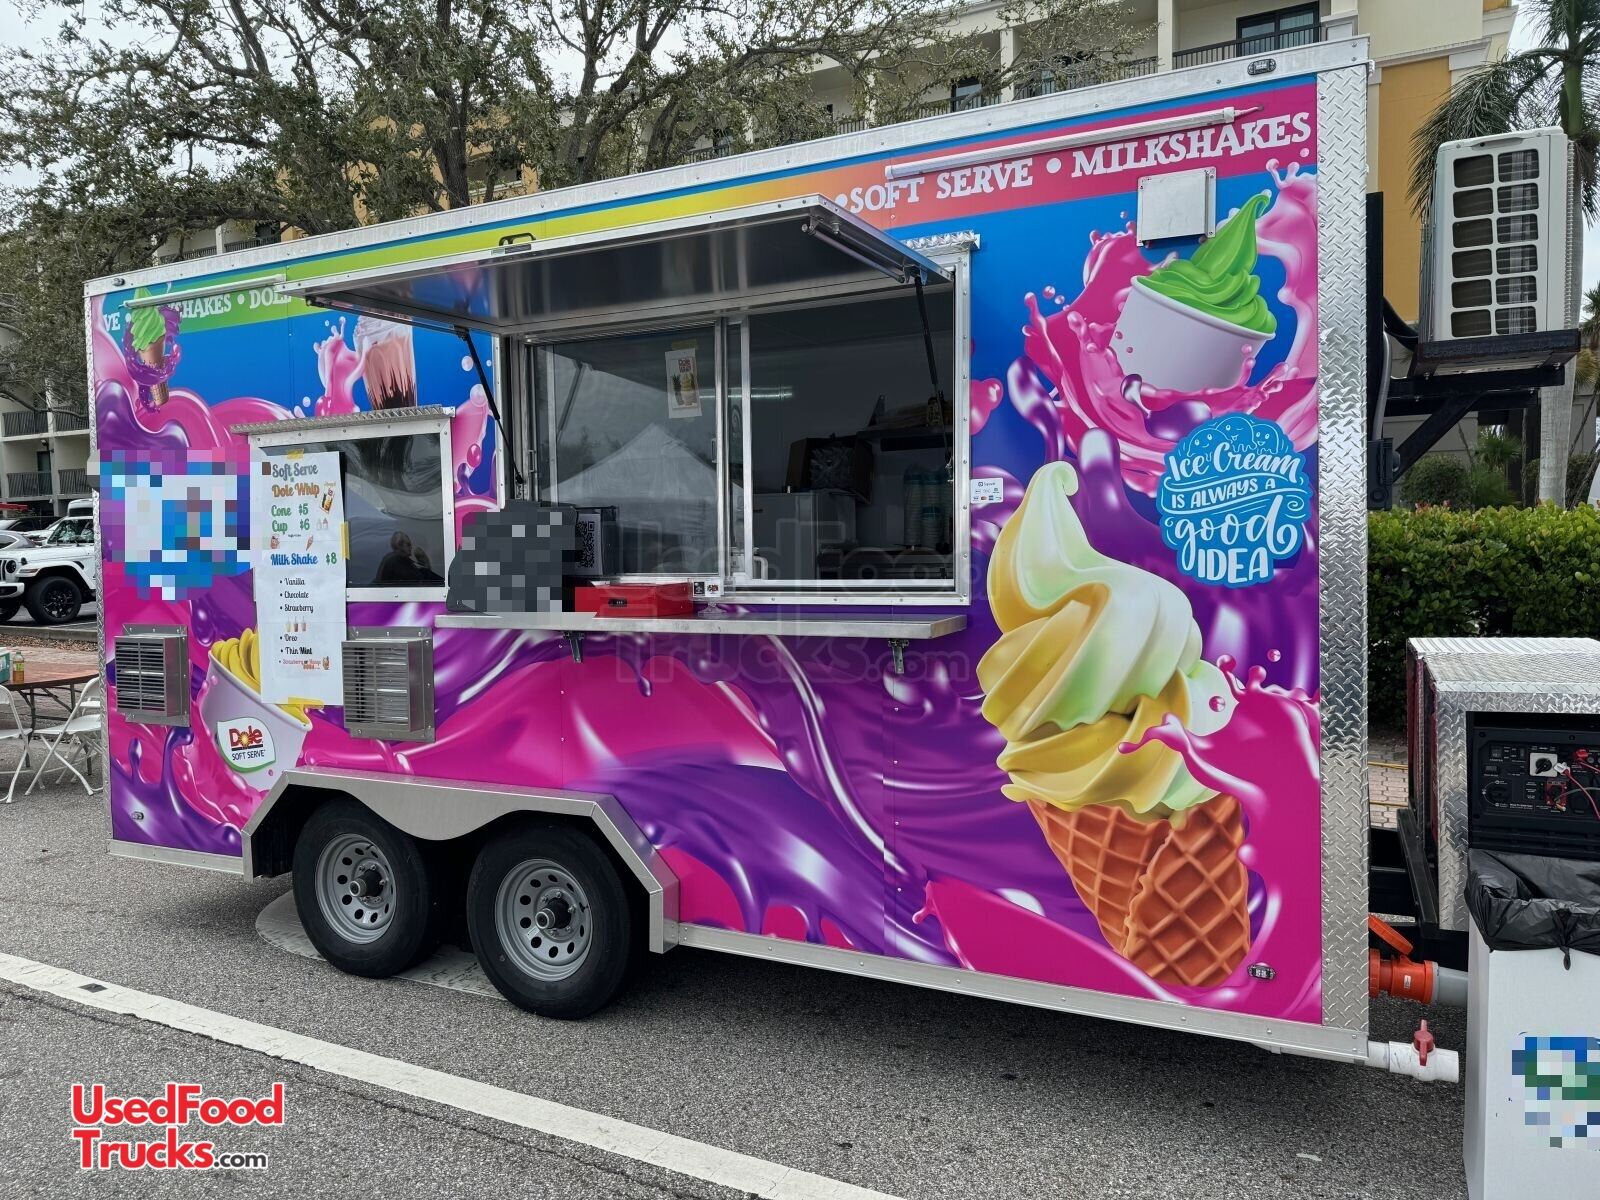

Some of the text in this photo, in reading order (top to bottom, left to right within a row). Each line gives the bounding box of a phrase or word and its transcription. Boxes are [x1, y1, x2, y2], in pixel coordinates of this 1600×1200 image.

[851, 112, 1312, 214] SOFT SERVE MILKSHAKES
[1169, 441, 1301, 483] Ice Cream
[272, 462, 319, 481] Soft Serve
[271, 482, 320, 498] Dole Whip
[1171, 478, 1276, 509] IS ALWAYS A
[271, 503, 309, 517] Cone $5
[271, 518, 310, 535] Cup $6
[1174, 495, 1298, 571] good
[270, 552, 338, 566] Milk Shake $8
[1198, 546, 1269, 583] IDEA
[284, 577, 306, 586] Vanilla
[284, 590, 309, 599] Chocolate
[284, 603, 314, 613] Strawberry
[284, 634, 298, 642] Oreo
[285, 646, 313, 655] Thin Mint
[228, 725, 263, 748] Dole
[231, 750, 265, 761] SOFT SERVE
